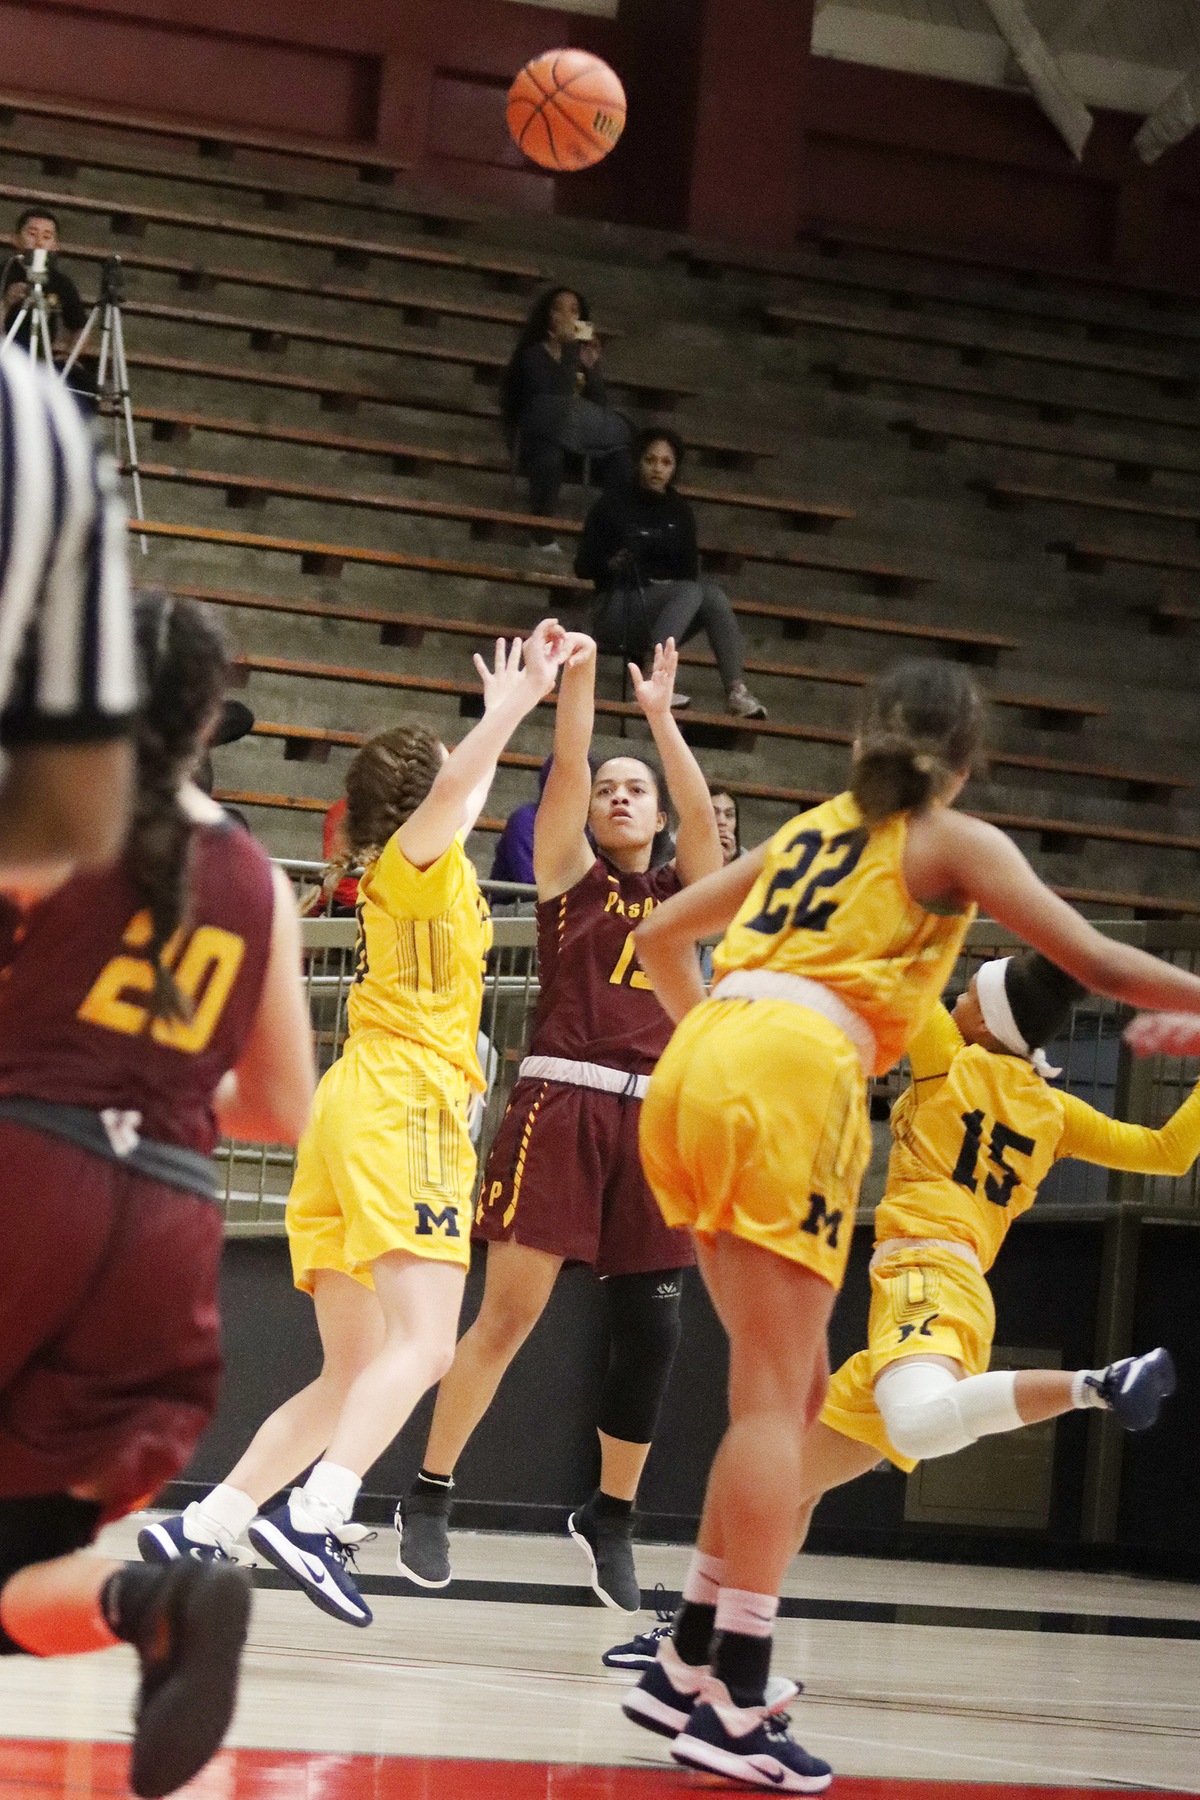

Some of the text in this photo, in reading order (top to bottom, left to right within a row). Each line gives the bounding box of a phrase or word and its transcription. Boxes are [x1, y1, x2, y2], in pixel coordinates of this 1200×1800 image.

[604, 891, 662, 918] PASA
[745, 827, 869, 935] 22
[609, 931, 655, 991] 1
[953, 1109, 1036, 1207] 15
[414, 1202, 460, 1237] M
[489, 1178, 503, 1206] P
[801, 1192, 843, 1248] M
